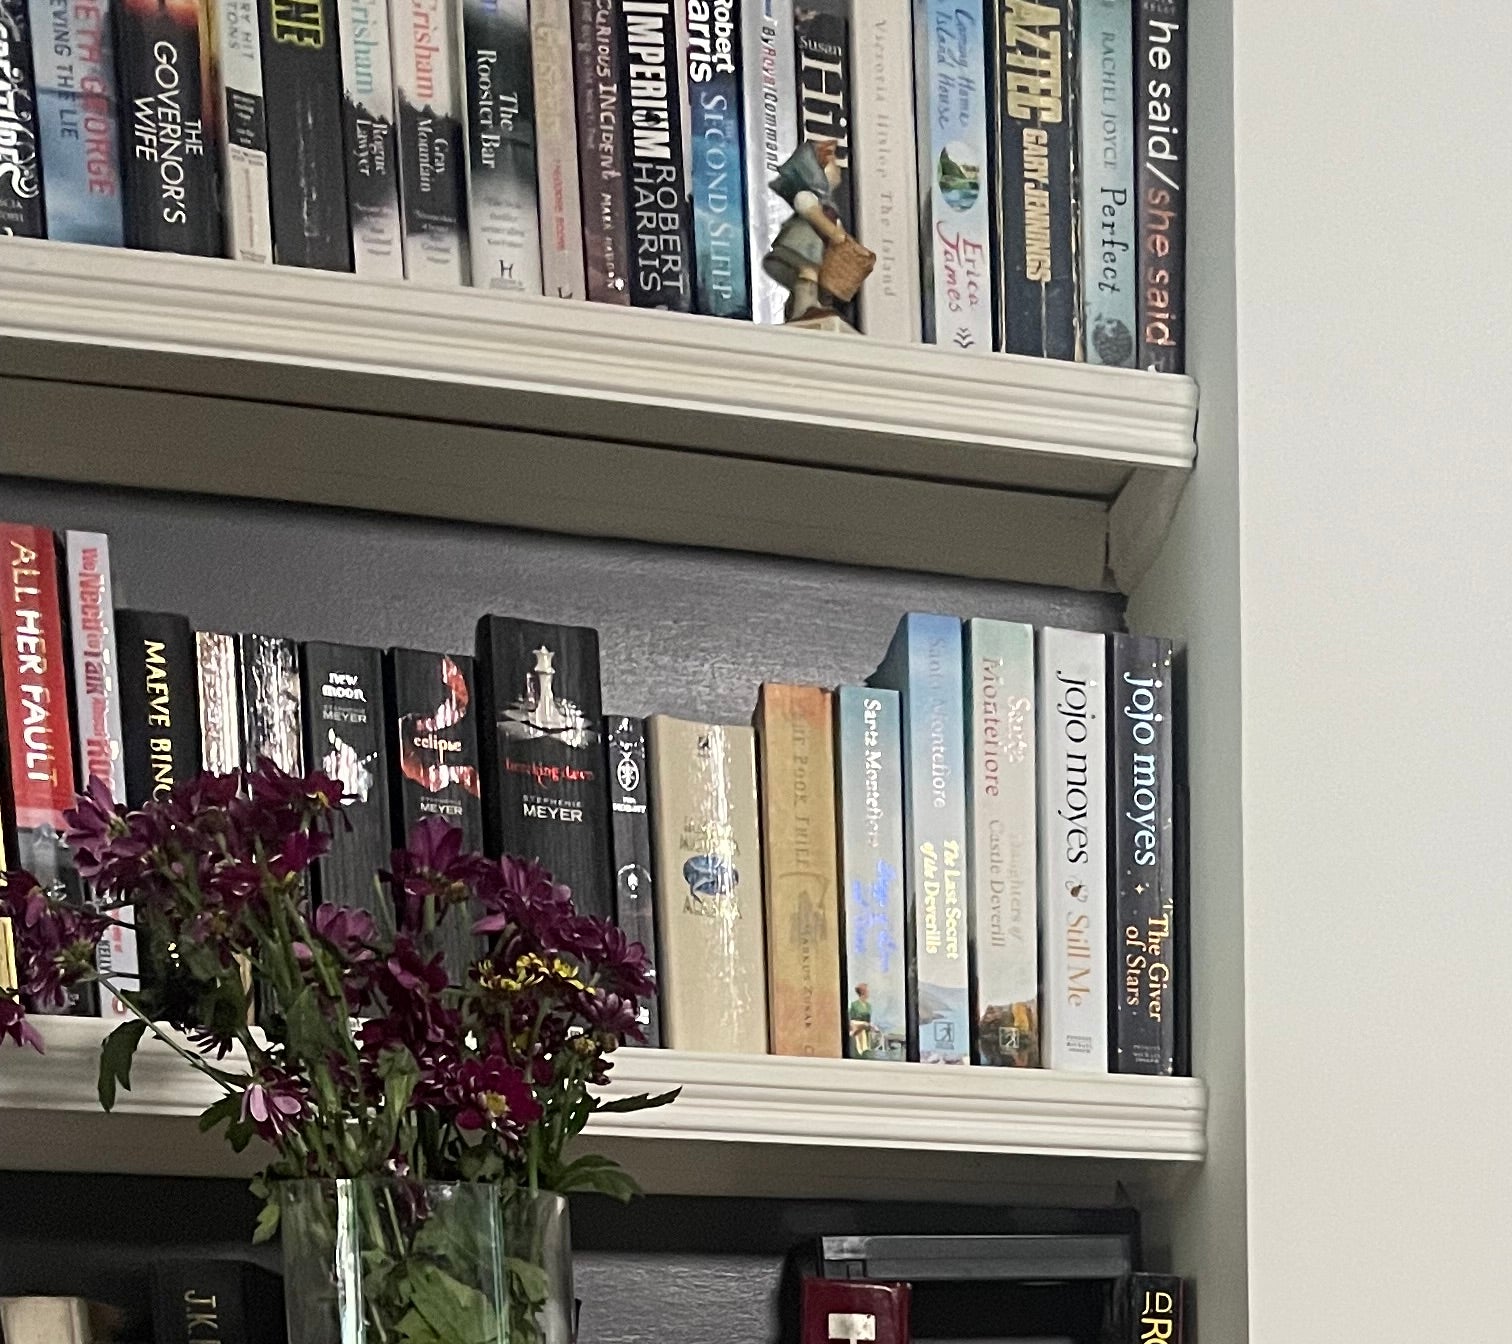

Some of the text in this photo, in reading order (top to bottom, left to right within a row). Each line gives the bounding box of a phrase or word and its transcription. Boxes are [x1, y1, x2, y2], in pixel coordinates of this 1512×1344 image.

[800, 37, 843, 55] Susan
[134, 97, 158, 163] WIFE
[153, 41, 187, 224] GOVERNOR'S
[184, 119, 204, 156] THE
[477, 50, 500, 168] Rooster Bar
[499, 92, 519, 132] The
[1004, 0, 1063, 283] AZTEC GARY JENNINGS
[417, 119, 435, 192] Mountain
[1098, 32, 1129, 294] RACHEL JOYCE Perfect
[633, 162, 660, 292] HARRIS
[656, 165, 686, 295] ROBERT
[936, 220, 961, 314] James
[962, 238, 983, 306] Erica
[10, 541, 46, 675] ALL HER
[321, 684, 367, 702] moon
[322, 710, 367, 724] MEYER
[329, 671, 359, 686] new
[420, 802, 463, 816] MEYER
[1124, 672, 1163, 867] jojo moyes
[523, 803, 583, 824] MEYER
[1056, 670, 1098, 1008] jojo moyes Still Me
[1125, 925, 1147, 1006] of Stars
[1148, 913, 1170, 1021] The Giver
